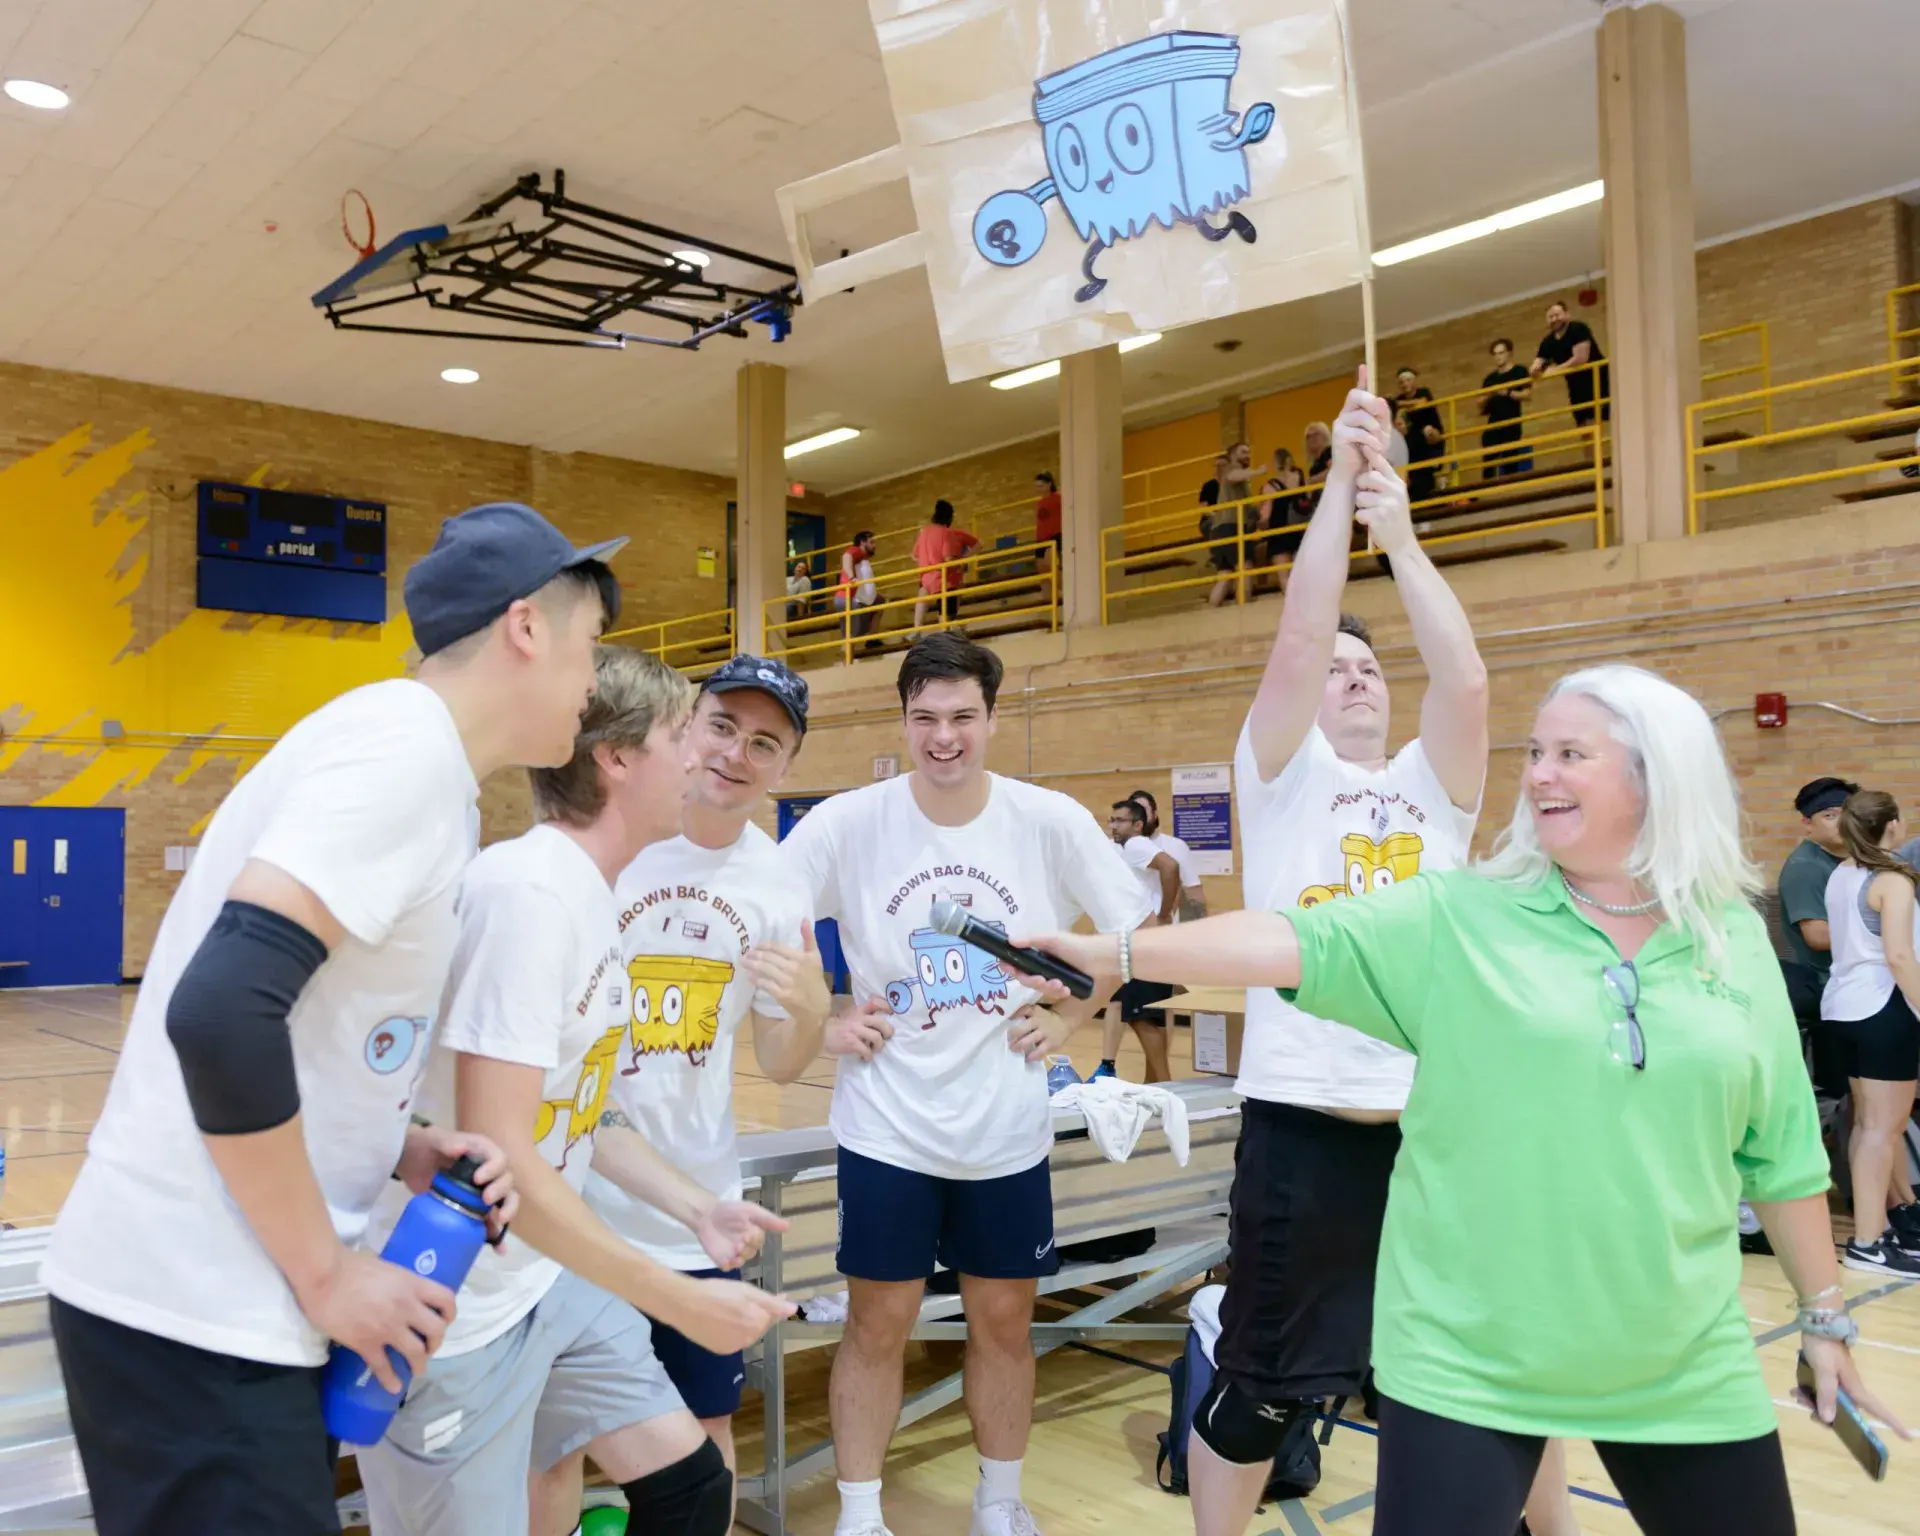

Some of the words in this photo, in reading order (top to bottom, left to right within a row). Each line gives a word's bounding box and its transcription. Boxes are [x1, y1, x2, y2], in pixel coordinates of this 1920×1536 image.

[279, 542, 316, 557] period
[1181, 772, 1218, 781] WELCOME
[886, 870, 931, 916] BROWN
[933, 865, 964, 878] BAG
[967, 867, 1019, 916] BALLERS
[677, 885, 709, 902] BAG
[712, 896, 750, 957] BRUTES
